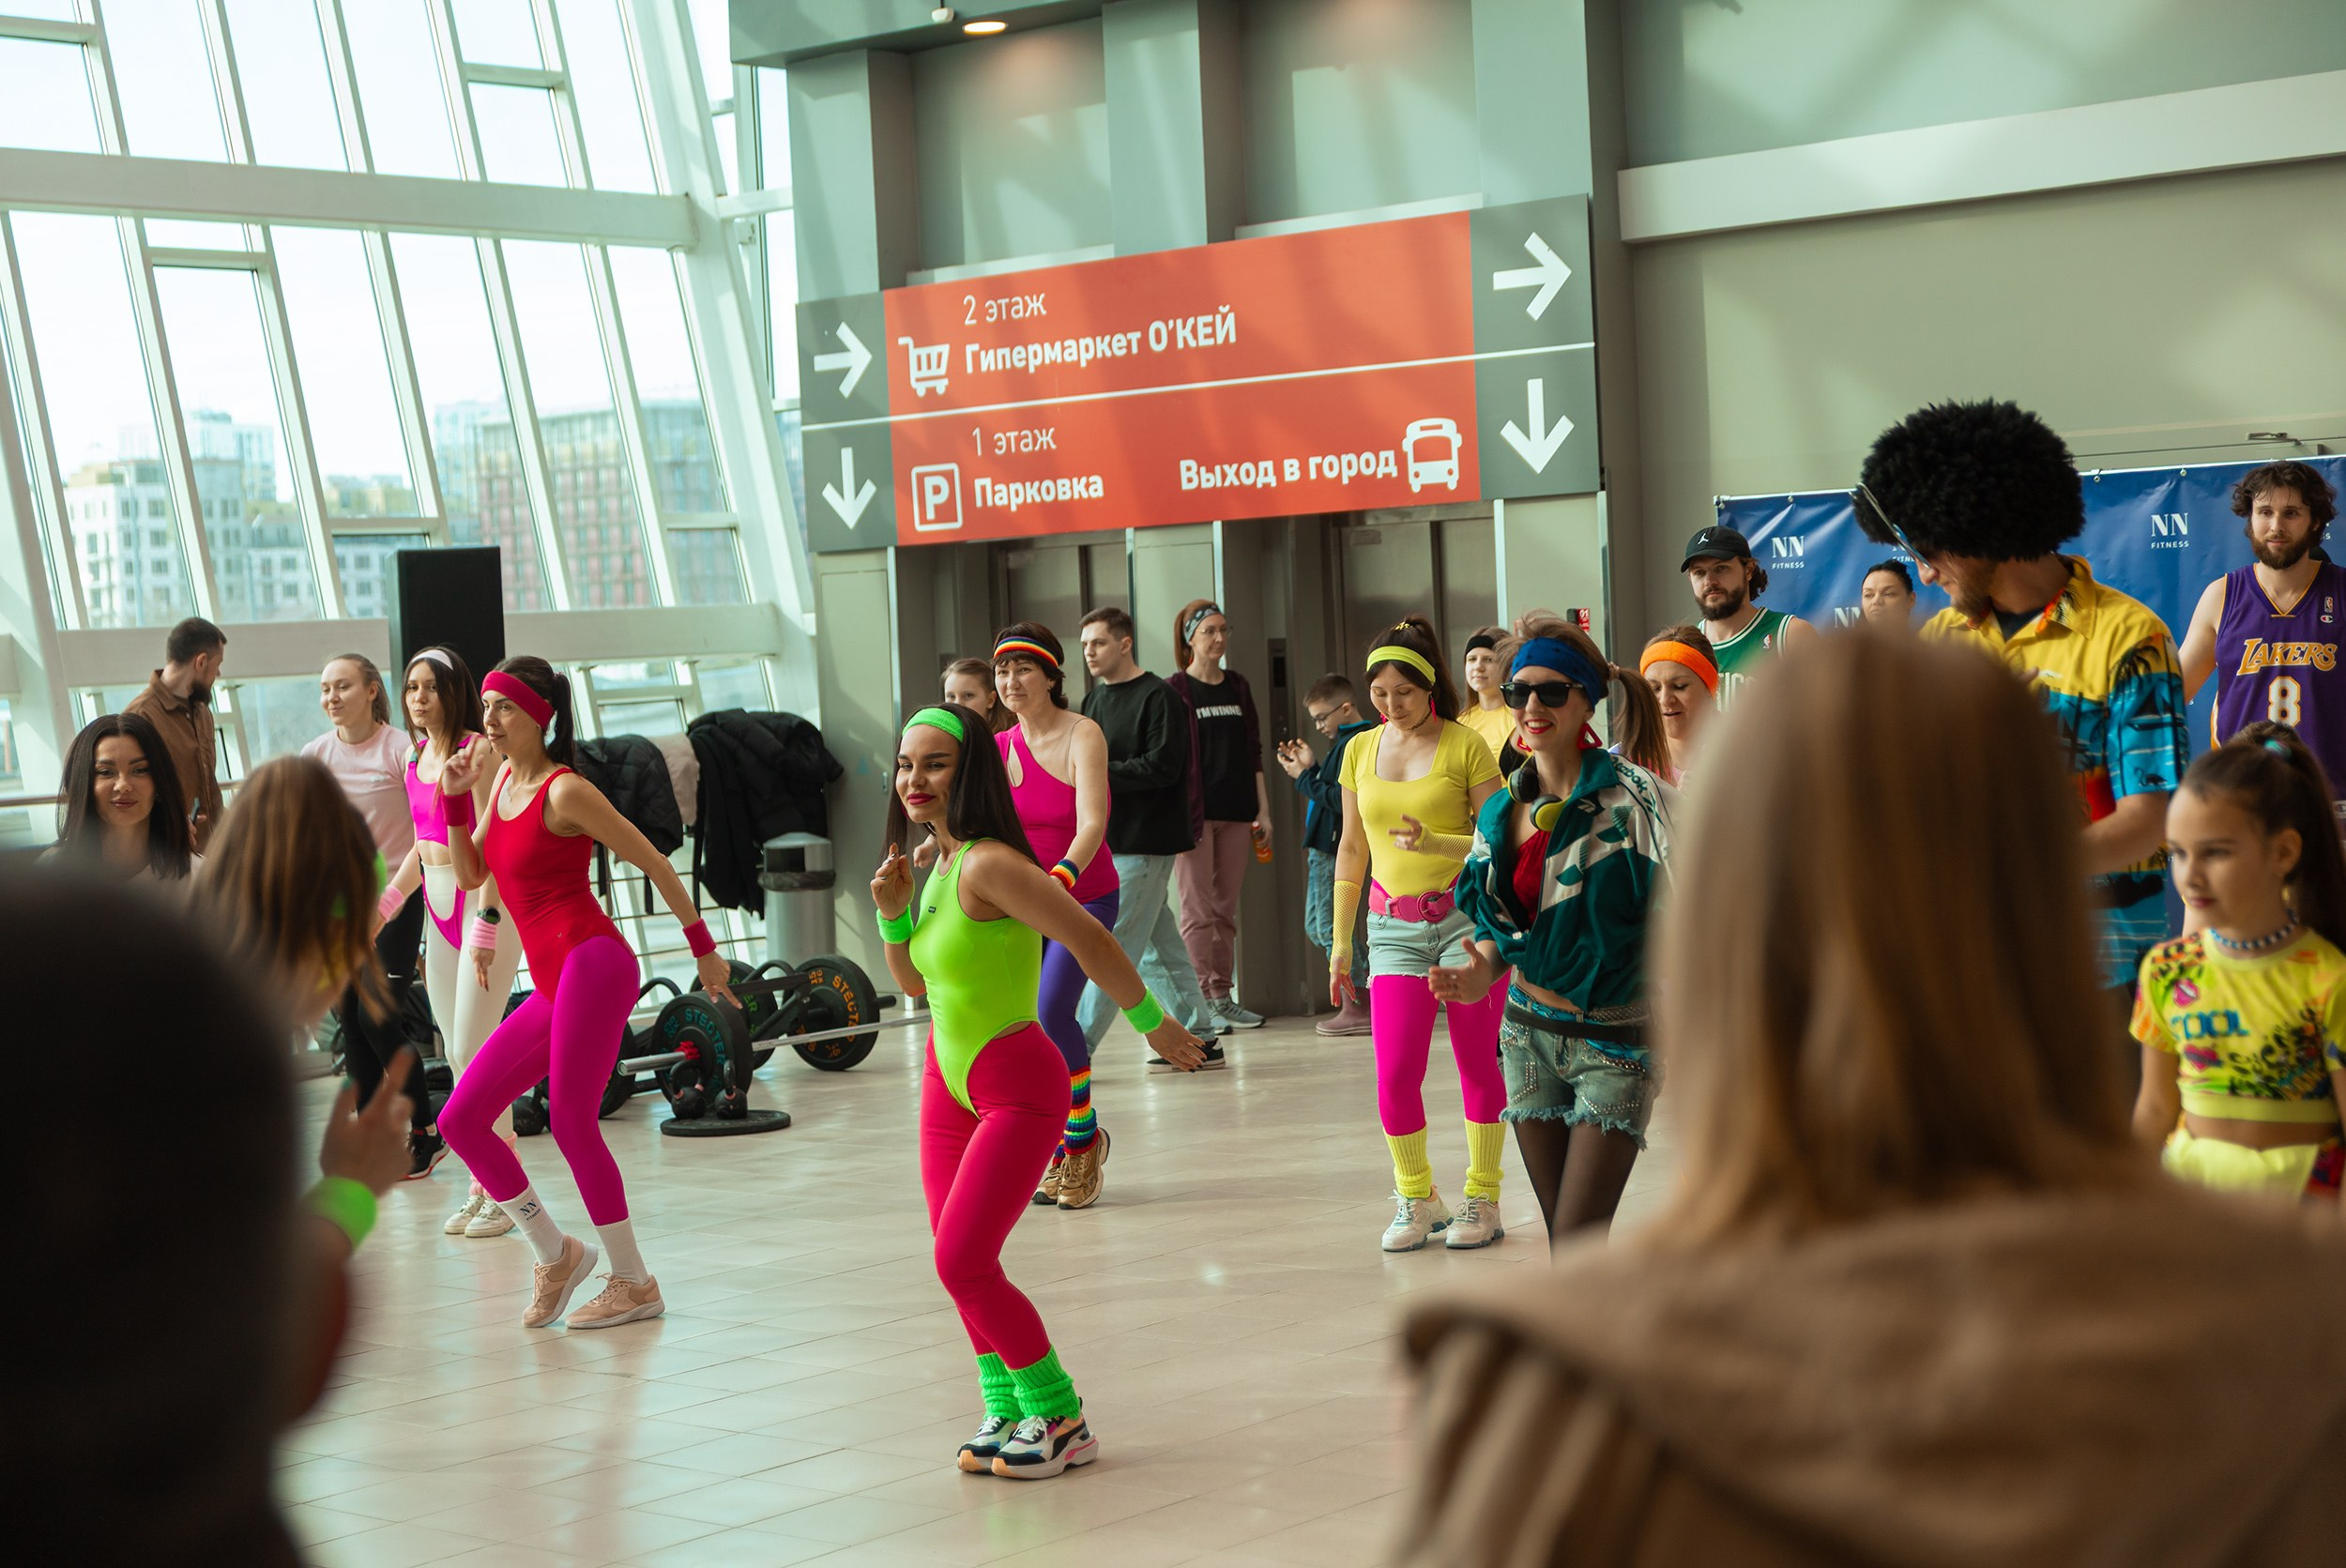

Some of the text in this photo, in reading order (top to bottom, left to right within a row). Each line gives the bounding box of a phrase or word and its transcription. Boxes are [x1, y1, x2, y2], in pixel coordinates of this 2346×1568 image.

[963, 293, 1047, 326] 2 этаж
[965, 330, 1142, 373] Гипермаркет
[972, 427, 1057, 457] 1 этаж
[1180, 449, 1398, 491] Выход в город
[974, 474, 1104, 512] Парковка
[2151, 512, 2188, 537] NN
[1771, 536, 1805, 558] NN
[2151, 540, 2189, 549] FITNESS
[1772, 561, 1805, 570] FITNESS
[2236, 637, 2338, 677] LAKERS
[2267, 675, 2302, 729] 8
[684, 1008, 726, 1065] STECTER
